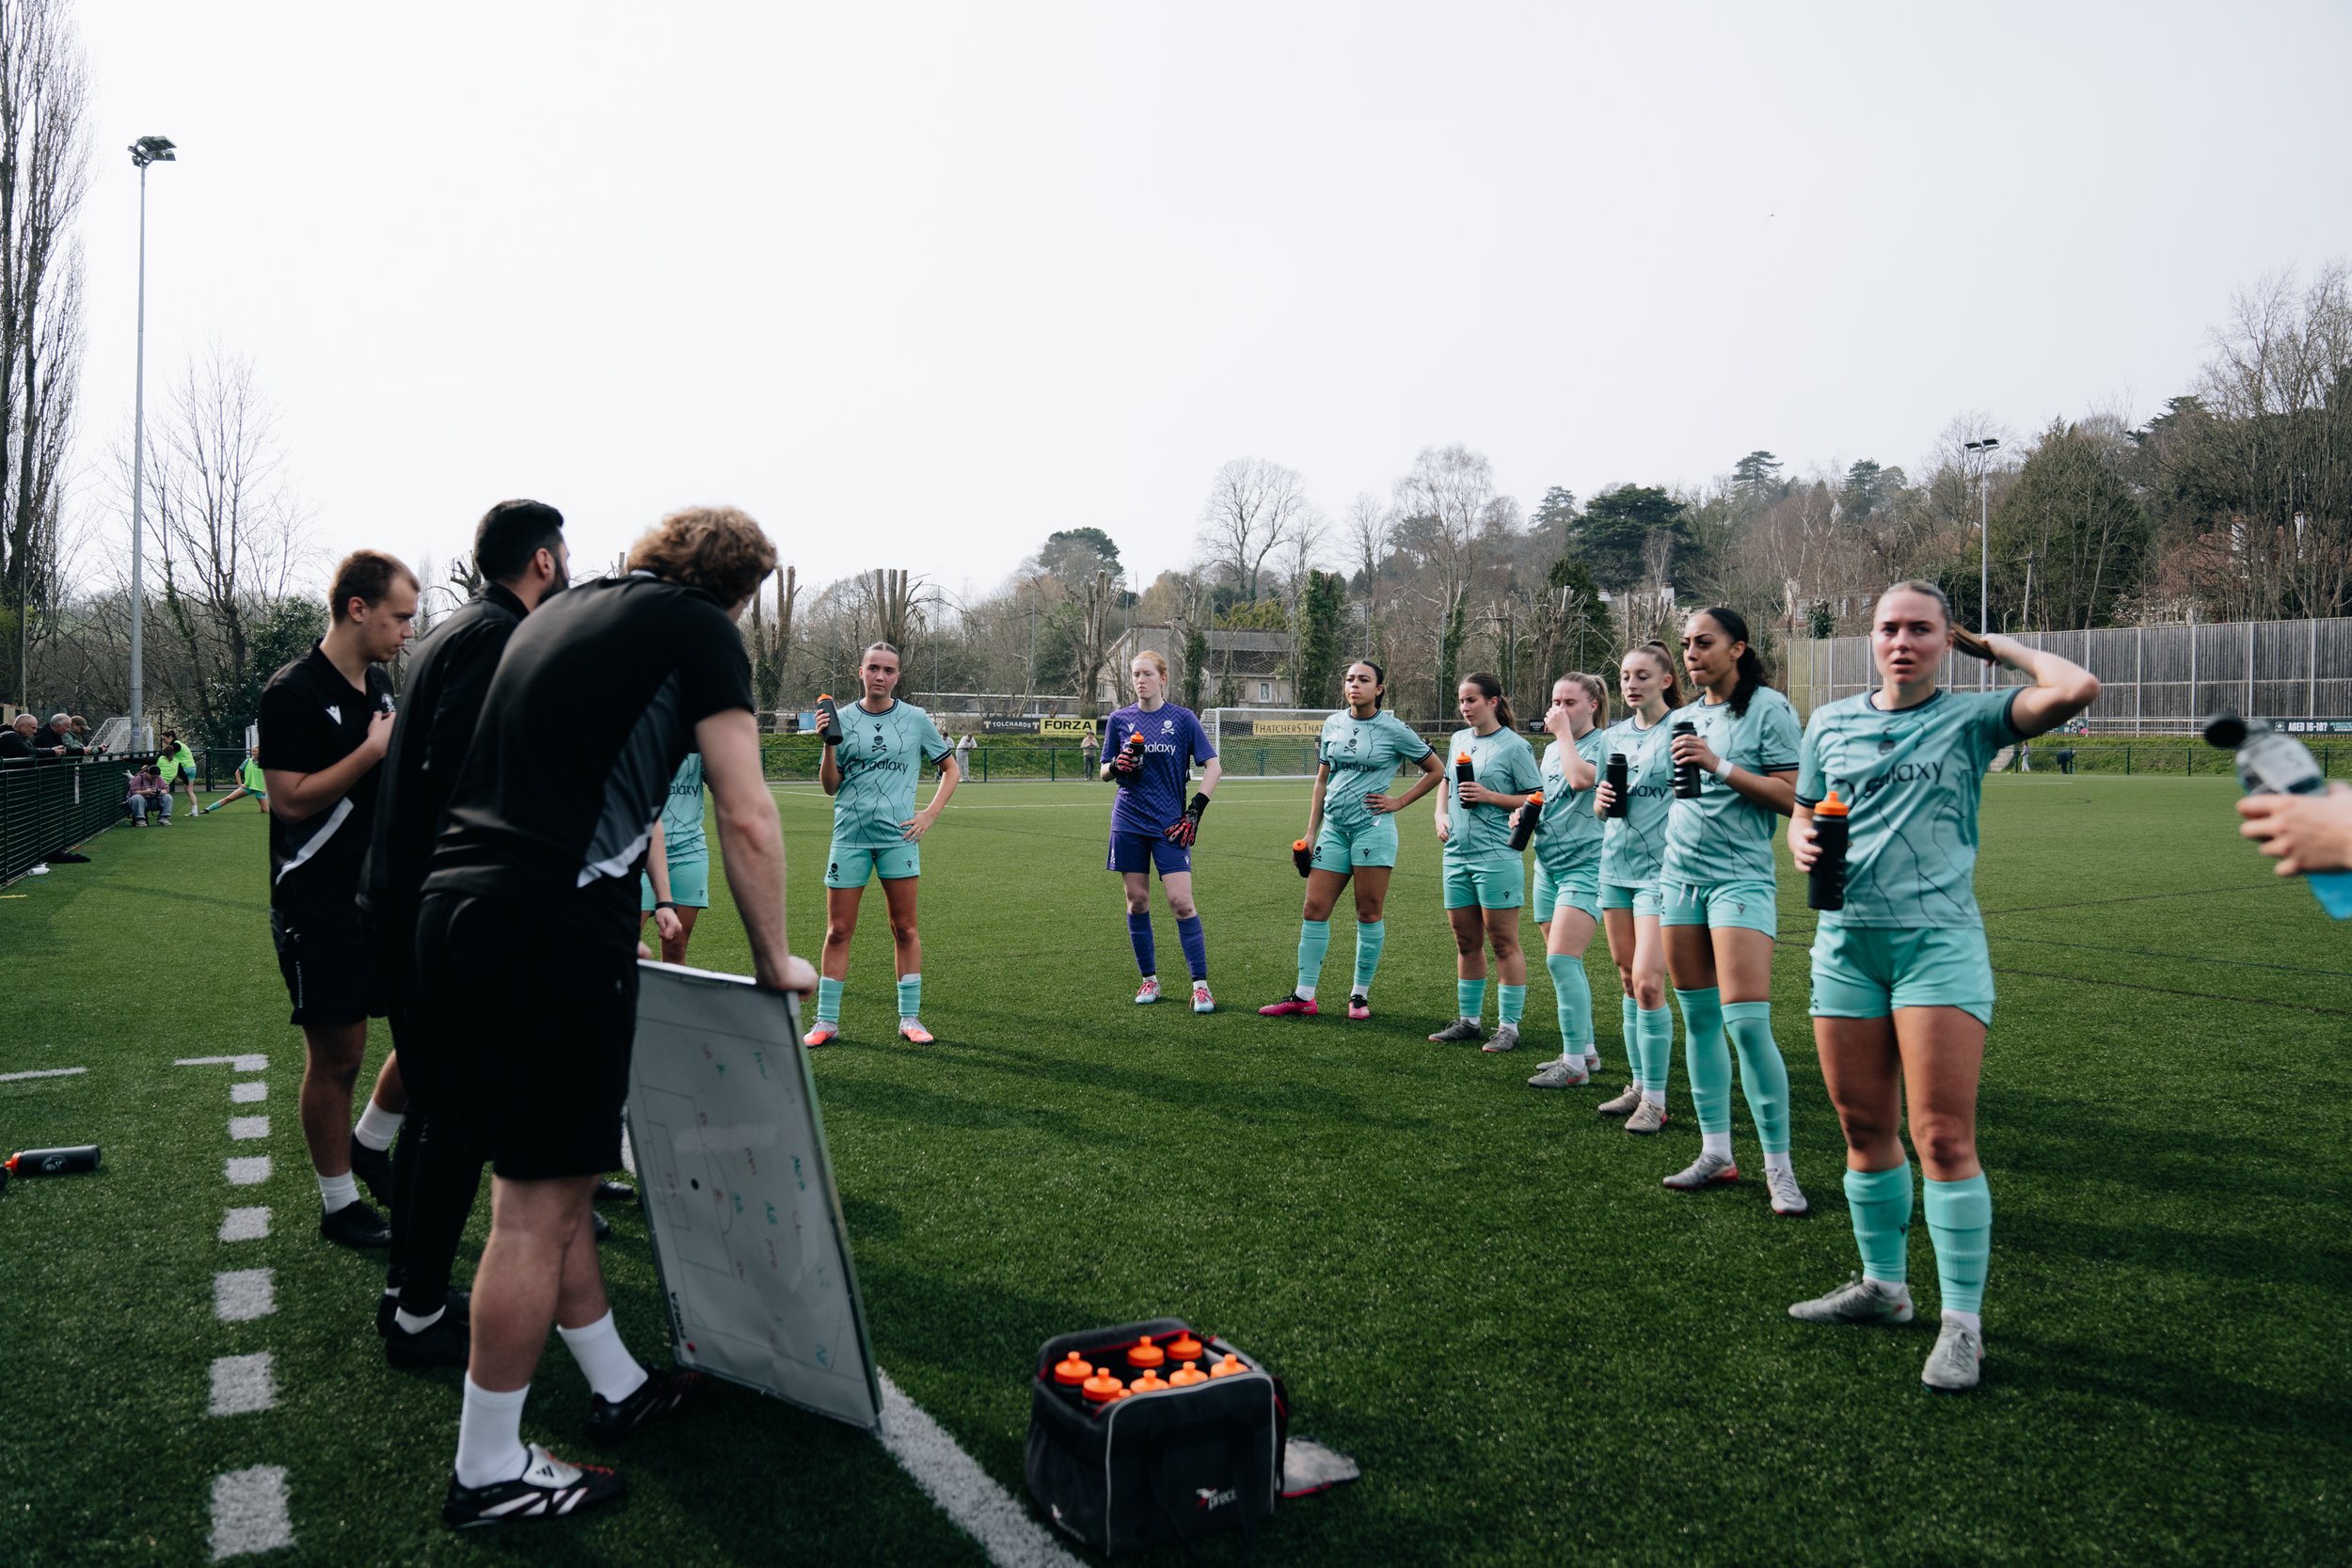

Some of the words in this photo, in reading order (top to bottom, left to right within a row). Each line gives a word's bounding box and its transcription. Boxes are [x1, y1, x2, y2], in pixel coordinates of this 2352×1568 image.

[1044, 720, 1092, 730] FORZA
[1254, 723, 1301, 734] THATCHERS
[2288, 721, 2305, 732] AGED
[868, 758, 908, 775] galaxy
[669, 783, 699, 798] alaxy
[1626, 784, 1668, 800] alaxy
